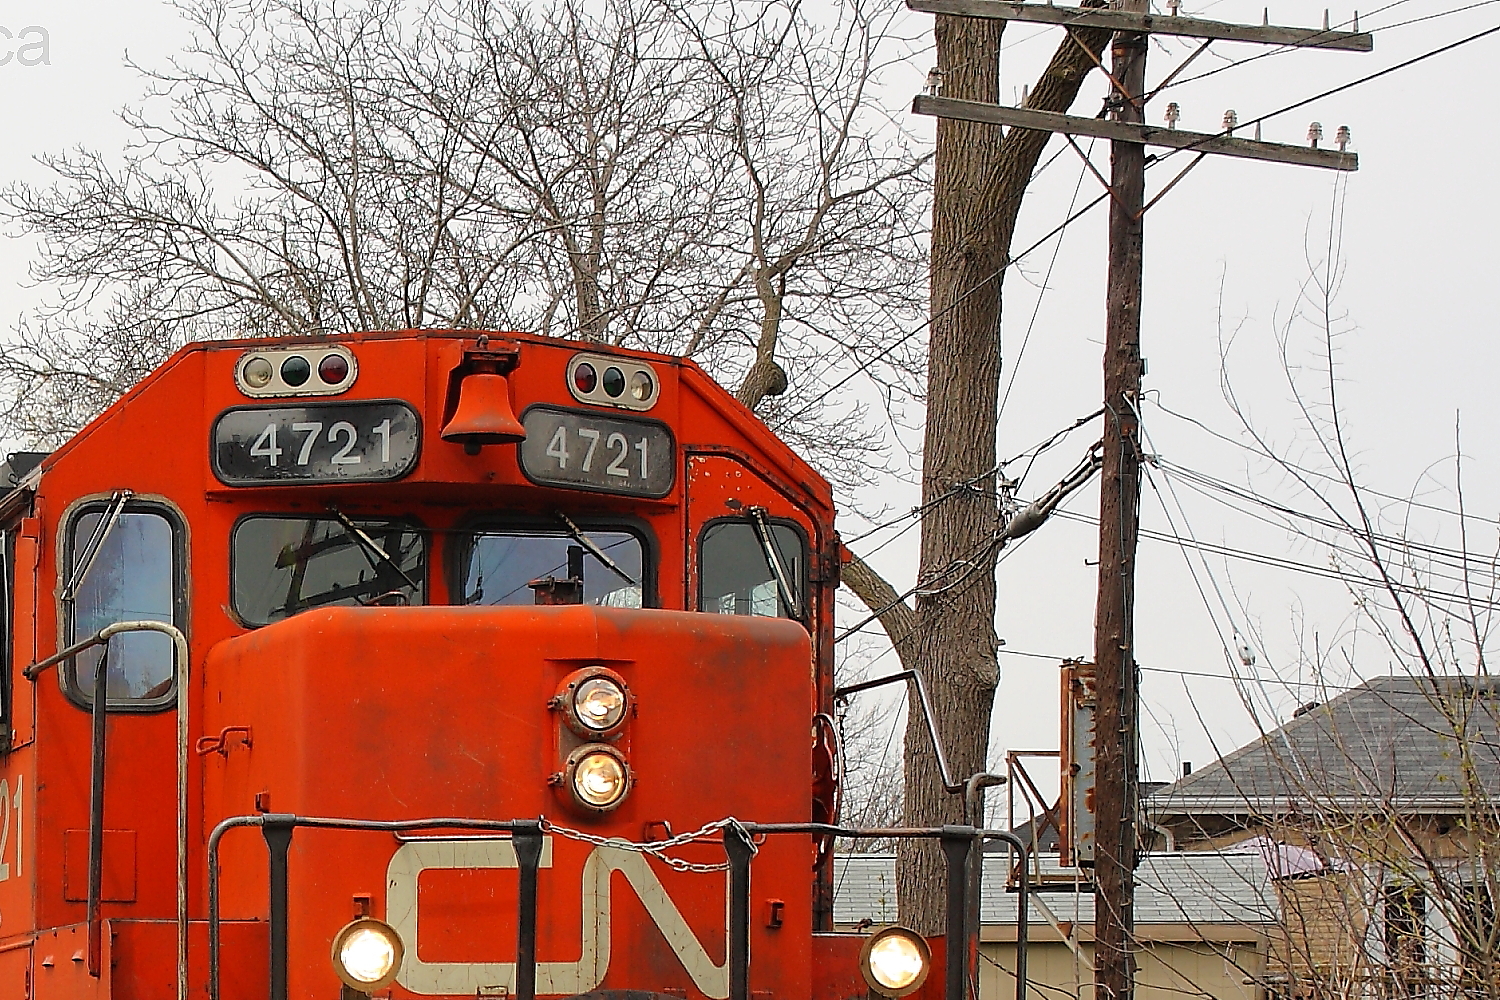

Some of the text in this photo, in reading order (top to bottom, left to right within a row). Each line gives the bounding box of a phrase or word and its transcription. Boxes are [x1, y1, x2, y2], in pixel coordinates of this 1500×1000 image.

[250, 419, 390, 466] 4721
[546, 426, 648, 479] 4721
[387, 835, 751, 1000] CN
